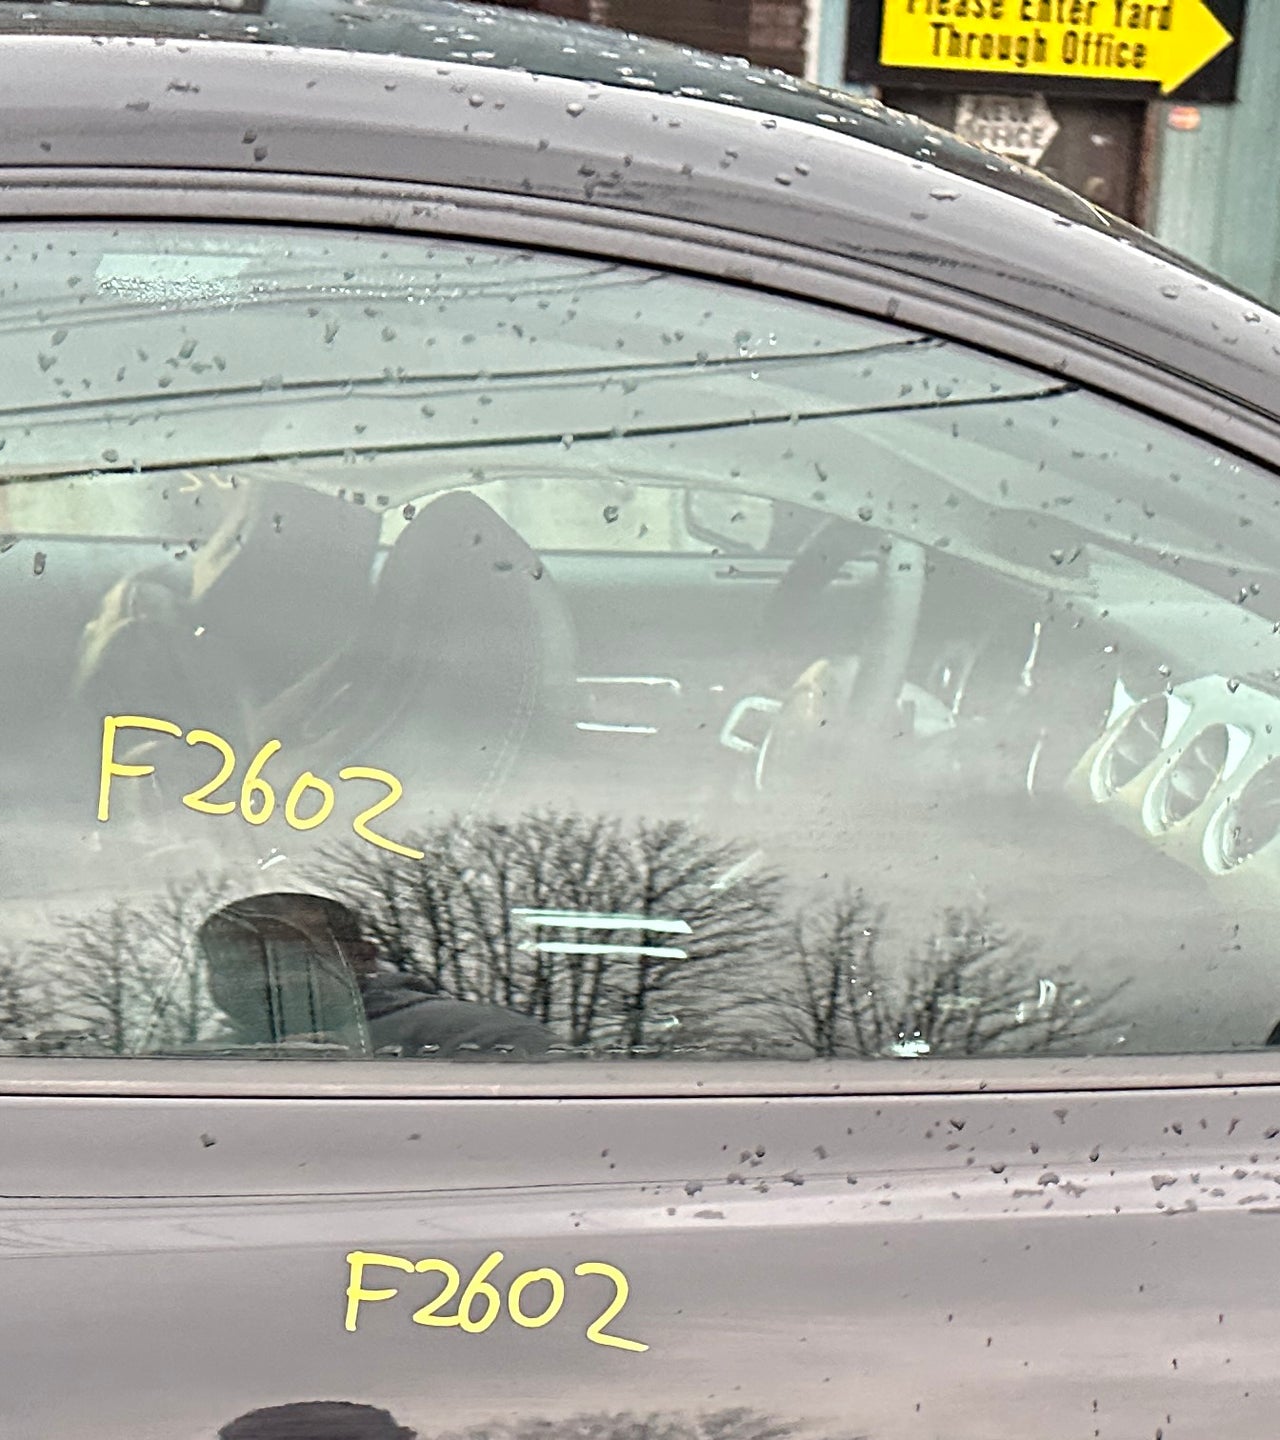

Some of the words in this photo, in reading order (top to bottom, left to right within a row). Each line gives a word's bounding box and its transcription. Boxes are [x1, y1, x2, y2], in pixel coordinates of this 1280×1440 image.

[929, 22, 1048, 67] Through
[1062, 30, 1148, 69] Office
[1114, 0, 1173, 30] Yard
[97, 715, 425, 859] F2602
[345, 1251, 649, 1352] F2602
